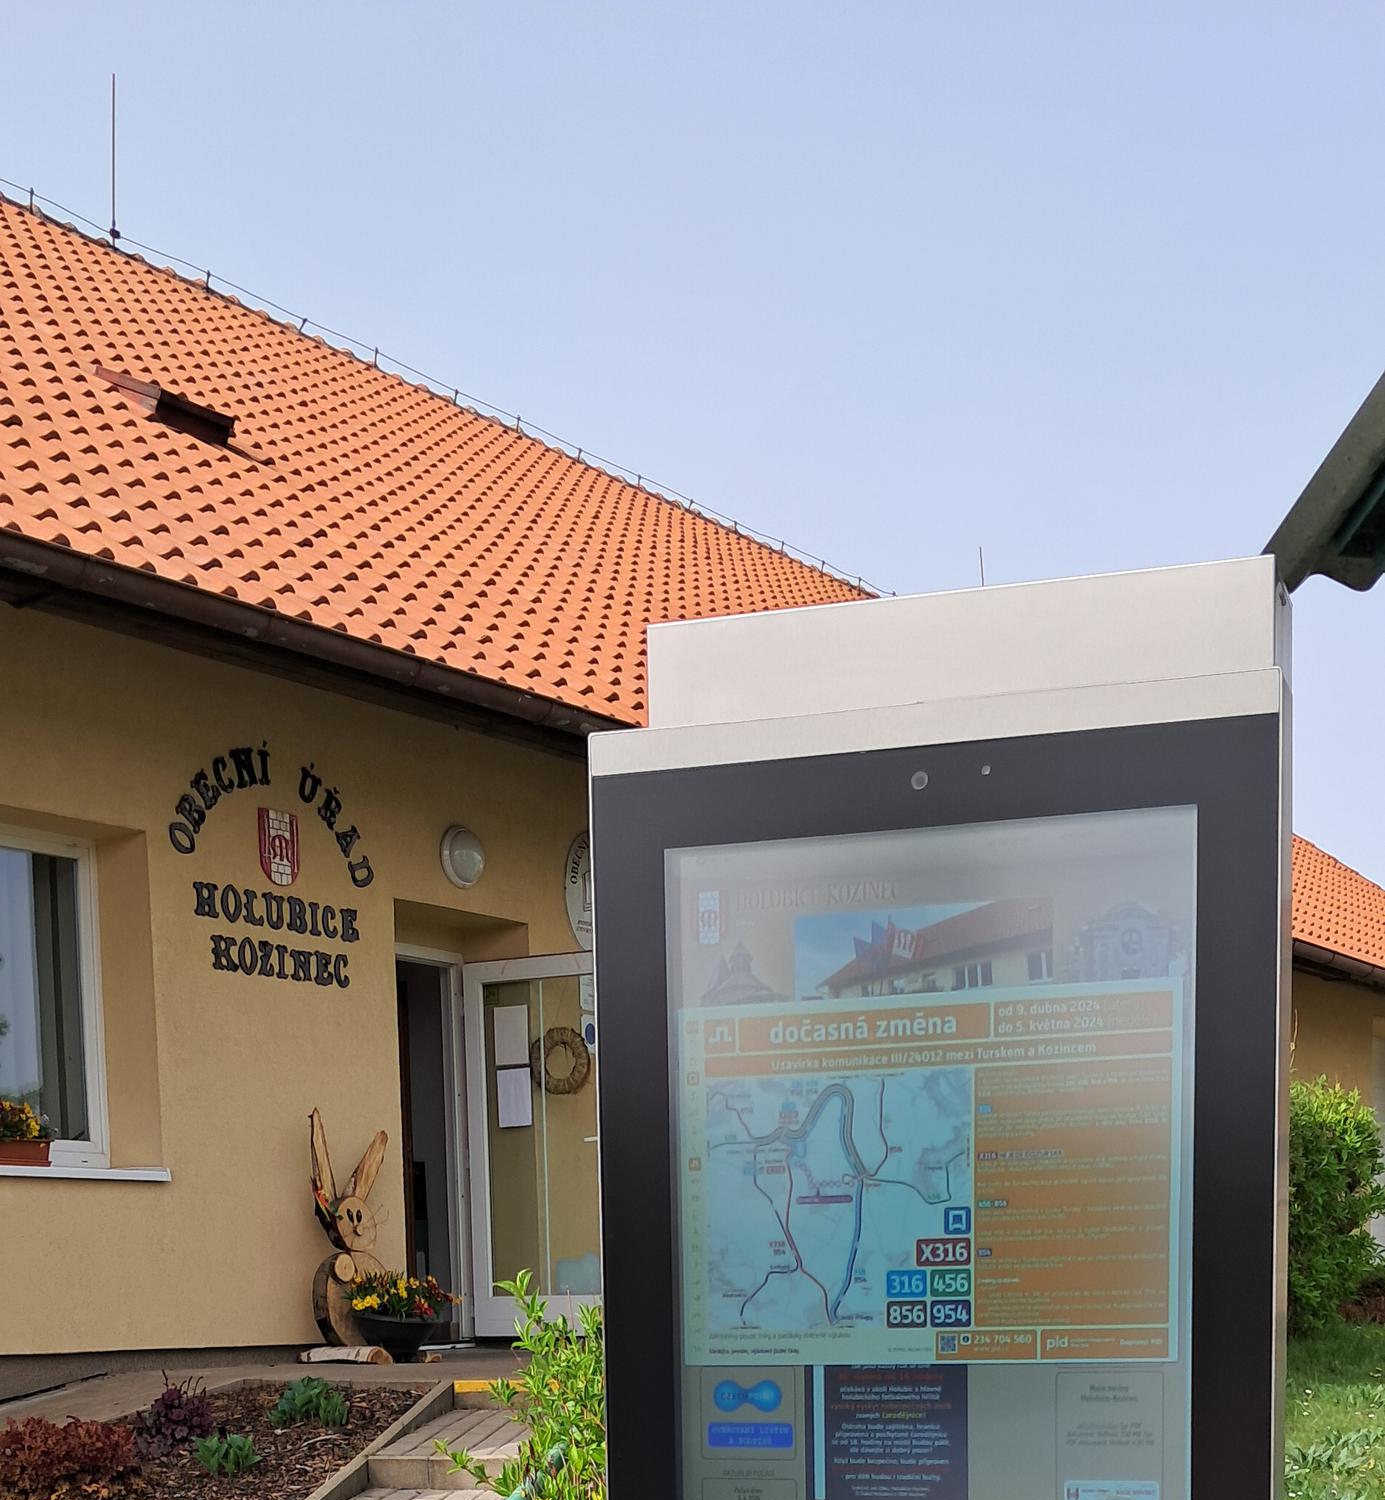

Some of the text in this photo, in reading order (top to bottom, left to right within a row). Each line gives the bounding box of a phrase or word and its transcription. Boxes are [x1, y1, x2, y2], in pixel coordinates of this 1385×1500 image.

[169, 739, 374, 888] OBECNÍ ÚŘAD
[193, 881, 360, 942] HOLUBICE
[210, 934, 350, 989] KOZINEC
[998, 1005, 1013, 1017] od
[1030, 1001, 1067, 1015] dubna
[1070, 1000, 1101, 1012] 2024
[769, 1011, 957, 1044] dočasná změna
[998, 1021, 1013, 1034] do
[1029, 1017, 1071, 1032] května
[1074, 1016, 1105, 1028] 2024
[771, 1042, 1097, 1071] Uzavírka komunikace III/24012 mezi Turskem a Kozincem
[920, 1243, 968, 1263] X316
[889, 1273, 969, 1294] 316 456
[888, 1305, 925, 1325] 856
[933, 1305, 969, 1324] 954
[974, 1334, 1032, 1344] 234 704 560
